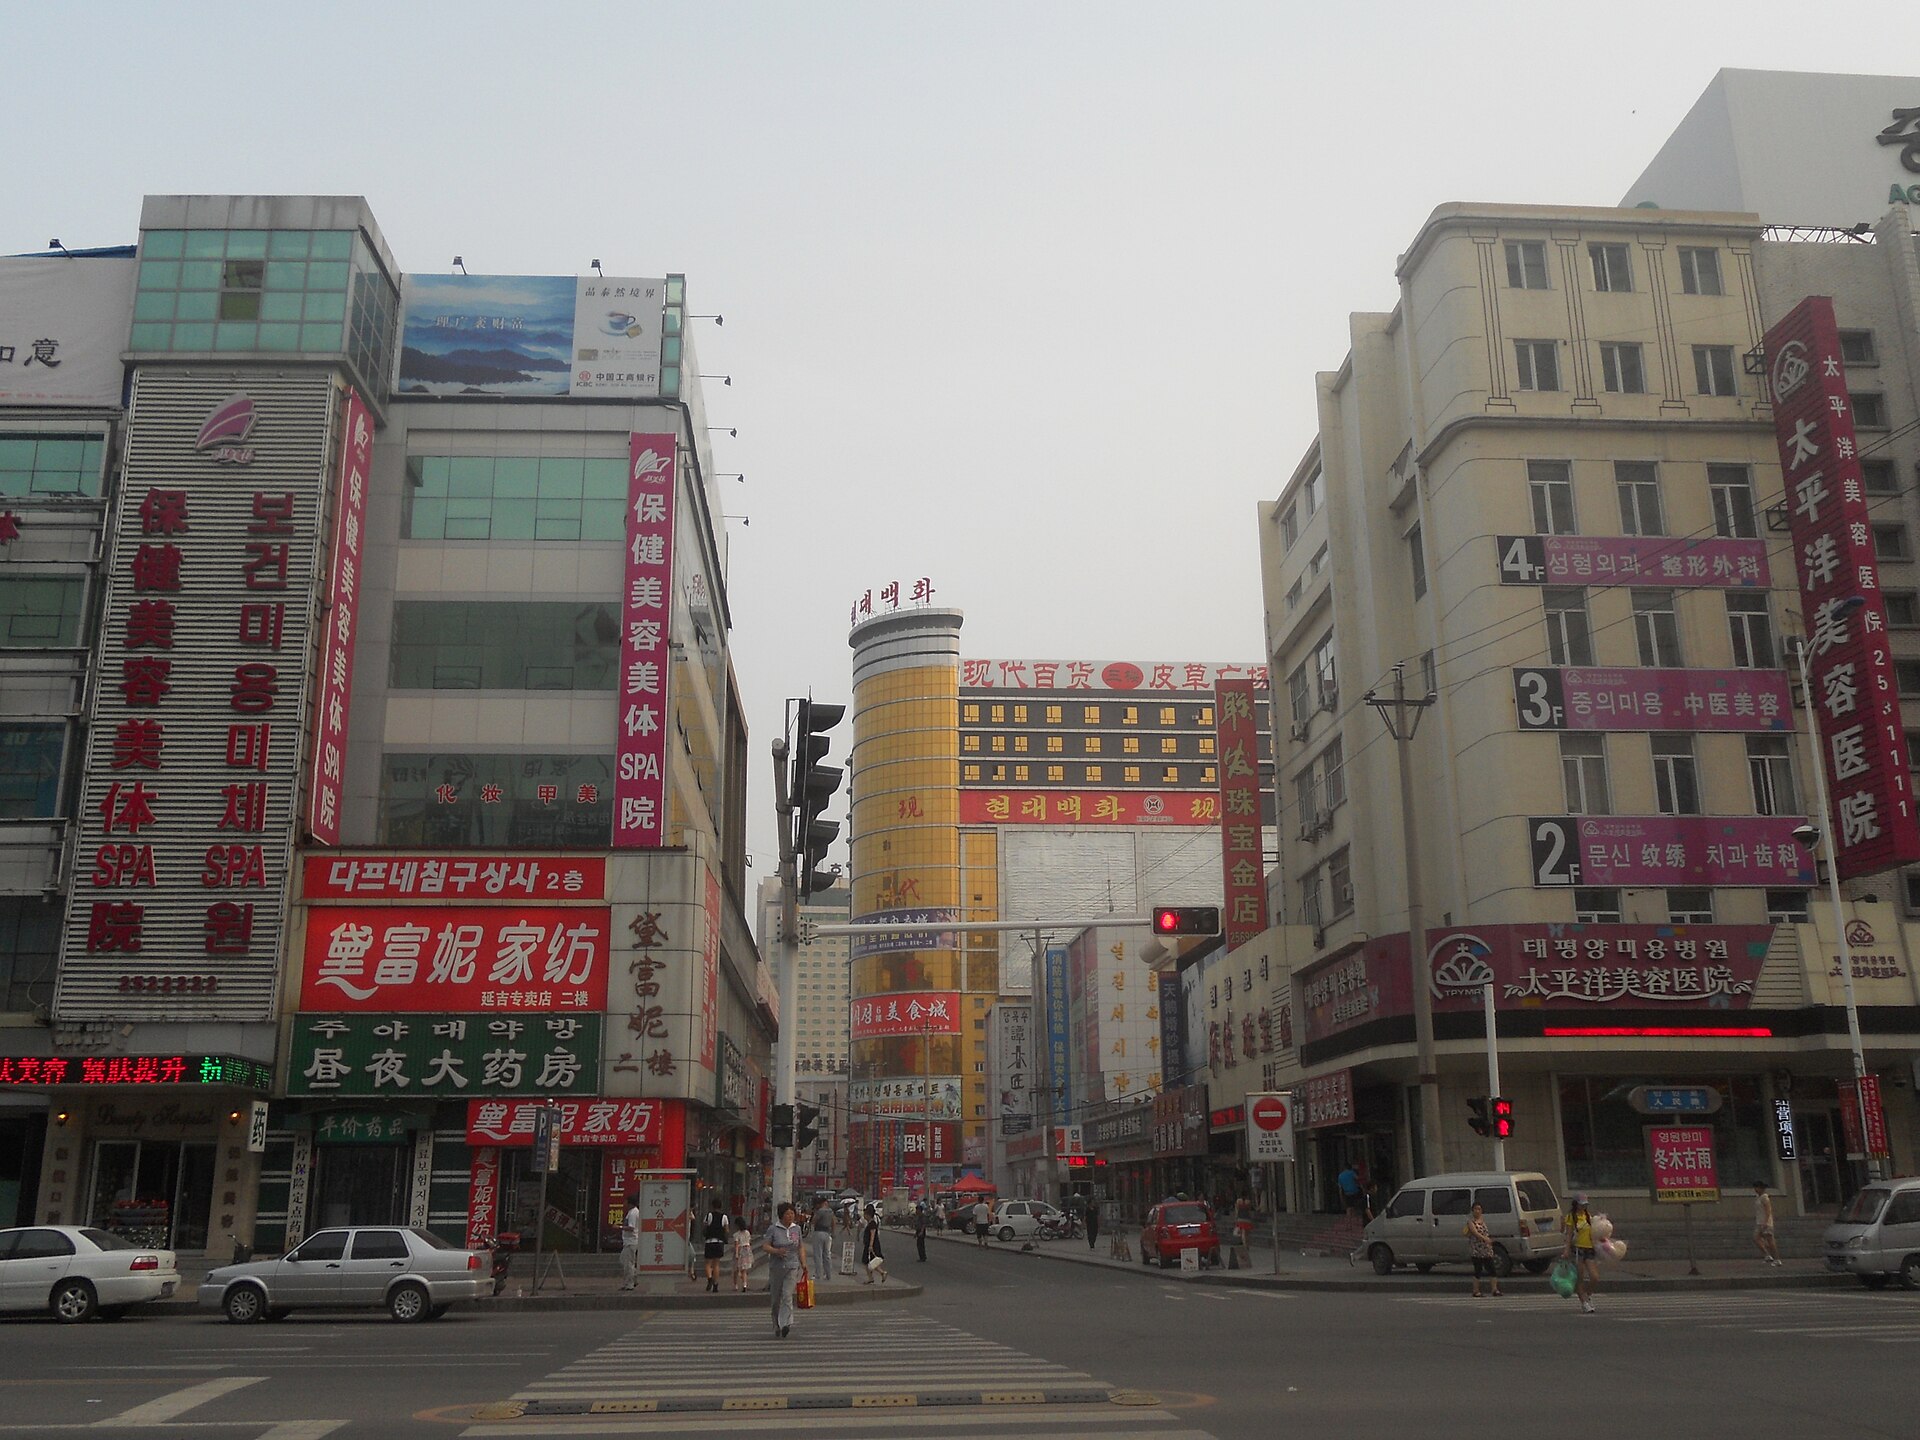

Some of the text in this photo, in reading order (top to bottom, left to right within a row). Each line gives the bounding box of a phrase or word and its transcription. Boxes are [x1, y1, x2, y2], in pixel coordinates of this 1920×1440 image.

[596, 372, 656, 383] 中国工商银行
[1823, 355, 1883, 633] 太平洋美容医院
[1502, 537, 1545, 580] 4F
[1549, 552, 1642, 578] 성형외과
[1662, 555, 1761, 580] 整形外科
[851, 578, 936, 627] 대백화
[1787, 418, 1880, 848] 太平洋美容医院
[620, 493, 667, 830] 保健美容美体SPA院
[963, 659, 1095, 690] 现代百货
[1518, 671, 1564, 727] 3F
[1571, 691, 1664, 717] 중의미용
[1683, 691, 1780, 718] 中医美容
[87, 487, 190, 953] 保健美容美体SPA院
[200, 490, 296, 954] 보건미용미체SPA원
[984, 794, 1126, 822] 현대백화
[1535, 821, 1580, 885] 2F
[1588, 843, 1631, 868] 문신
[1706, 843, 1749, 868] 치과
[1754, 843, 1800, 869] 齿科
[328, 861, 584, 893] 다프네침구상사 2층
[318, 920, 600, 986] 黛富妮家纺
[1522, 937, 1729, 960] 태평양미용병원
[628, 911, 669, 1041] 黛富妮
[1517, 965, 1736, 997] 太平洋美容医院
[481, 990, 589, 1008] 延吉专卖店 二楼
[886, 1000, 950, 1022] 美食城
[308, 1018, 584, 1042] 주야대약방
[303, 1045, 584, 1089] 昼夜大药房
[613, 1049, 678, 1078] 二楼
[252, 1108, 265, 1146] 药
[319, 1115, 404, 1139] 平价药品
